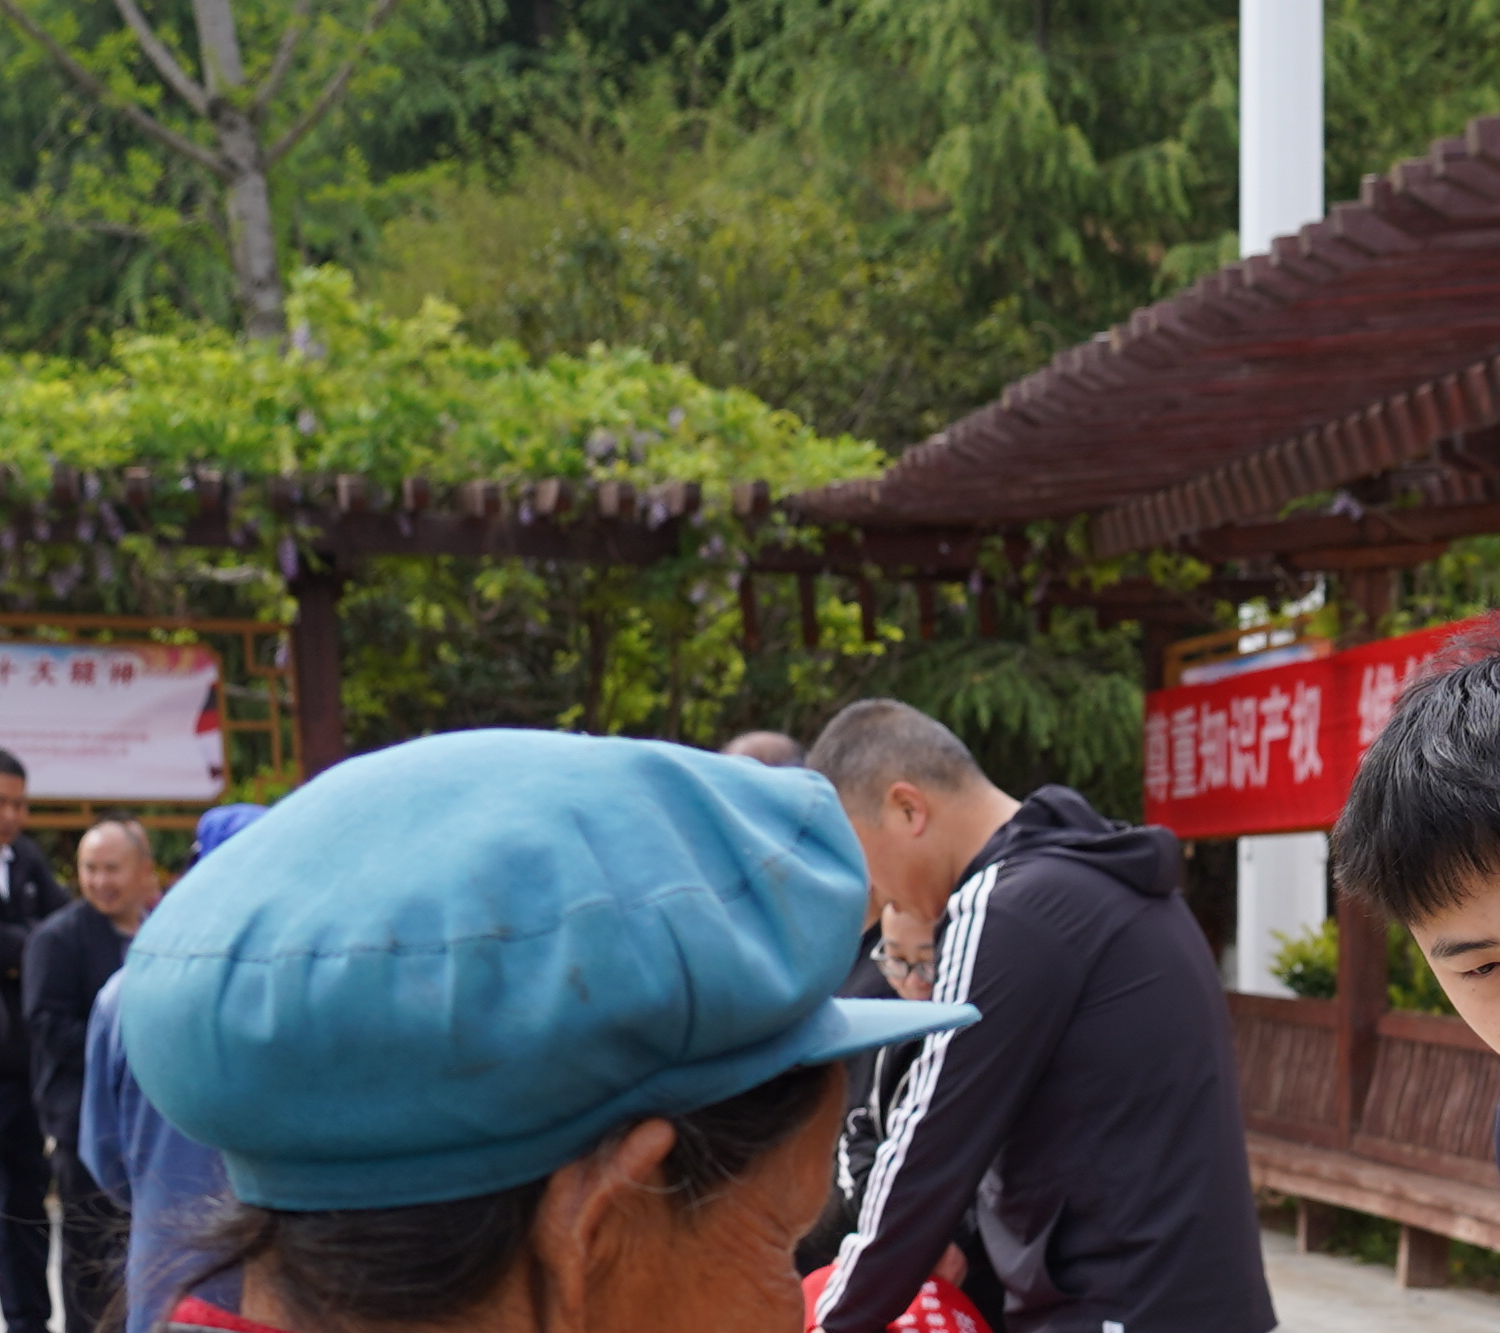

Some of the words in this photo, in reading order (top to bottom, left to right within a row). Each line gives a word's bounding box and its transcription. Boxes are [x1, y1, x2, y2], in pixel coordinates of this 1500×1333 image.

[1143, 681, 1323, 803] 尊重知识产权
